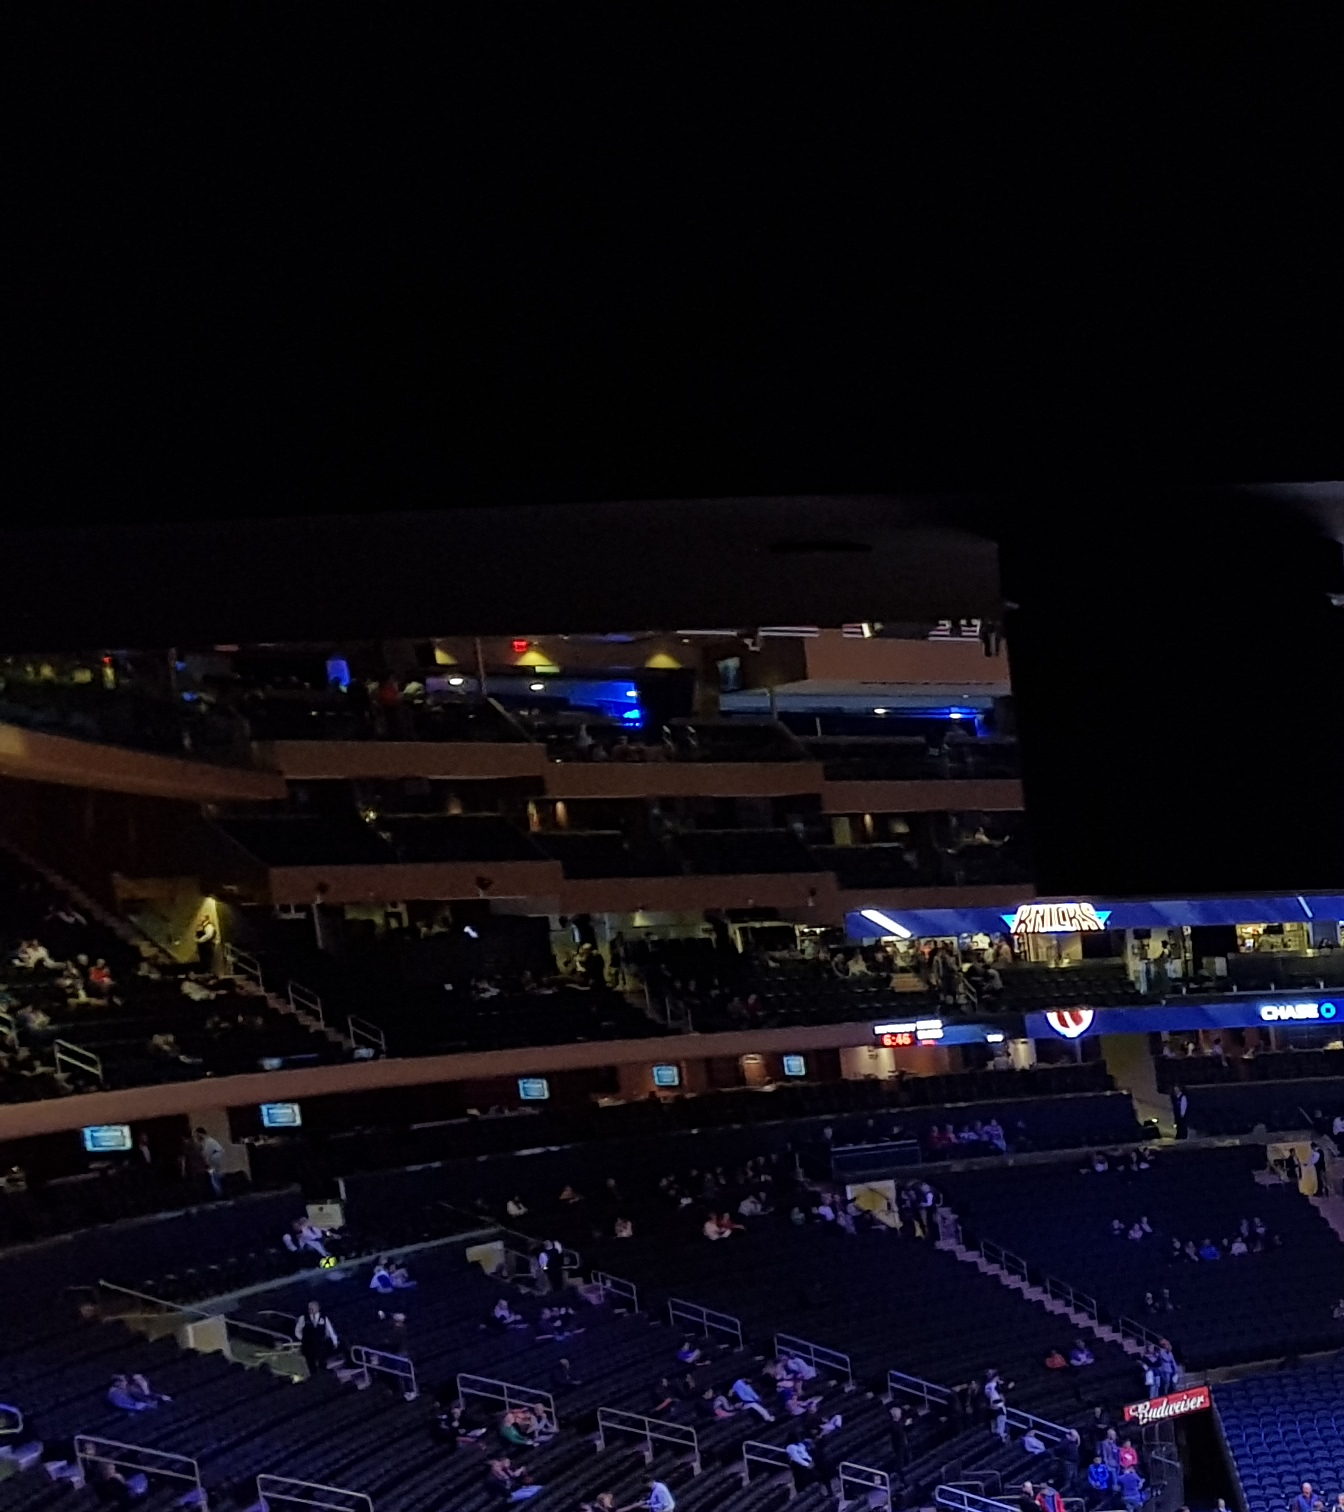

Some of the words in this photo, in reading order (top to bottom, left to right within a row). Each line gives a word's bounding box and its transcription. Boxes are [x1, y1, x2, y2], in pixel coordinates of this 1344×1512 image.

[1010, 903, 1105, 934] KNICKS
[1261, 1003, 1320, 1021] CHASE
[1129, 1394, 1204, 1425] Budweiser
